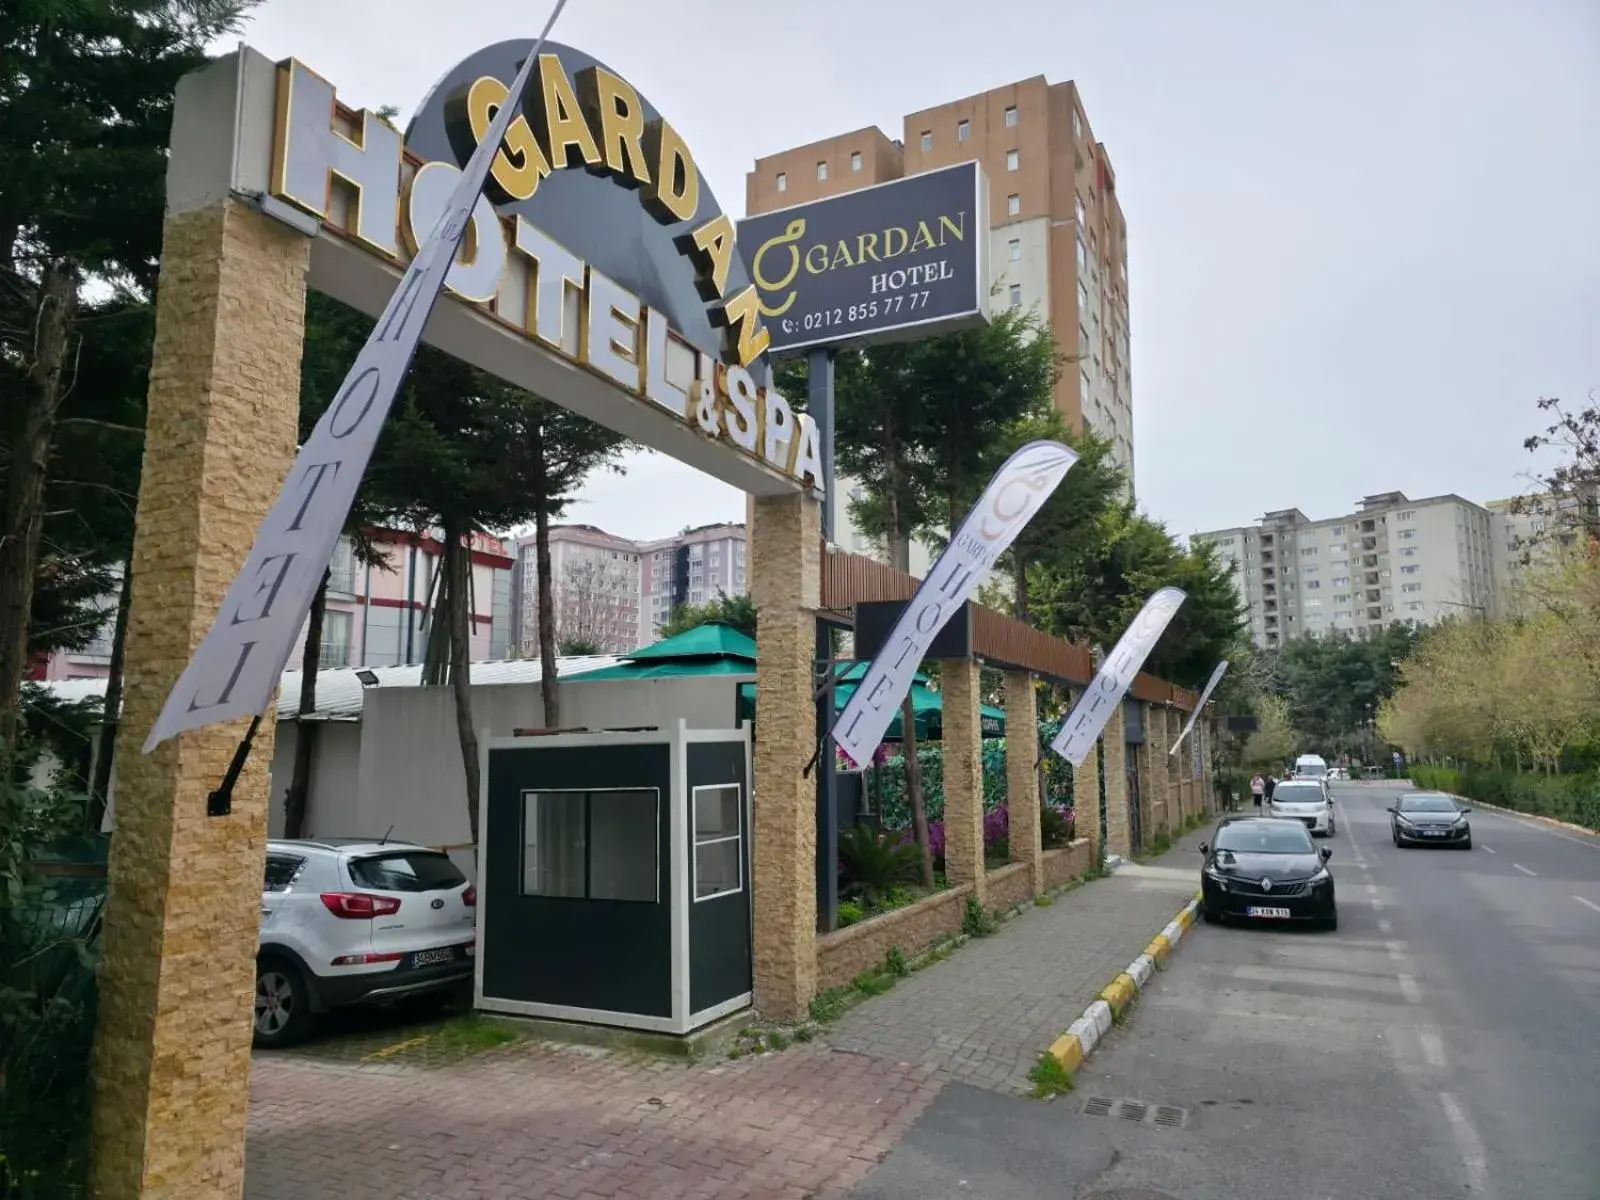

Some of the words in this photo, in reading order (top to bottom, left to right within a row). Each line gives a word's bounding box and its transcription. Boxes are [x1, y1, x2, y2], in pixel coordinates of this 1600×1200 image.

[275, 57, 691, 420] HOTEL
[465, 52, 770, 370] GARDAN
[805, 211, 966, 274] GARDAN
[803, 307, 843, 331] 0212
[847, 301, 878, 323] 855
[883, 296, 904, 315] 77
[909, 290, 931, 310] 77
[871, 260, 954, 294] HOTEL
[843, 562, 973, 749] HOTEL
